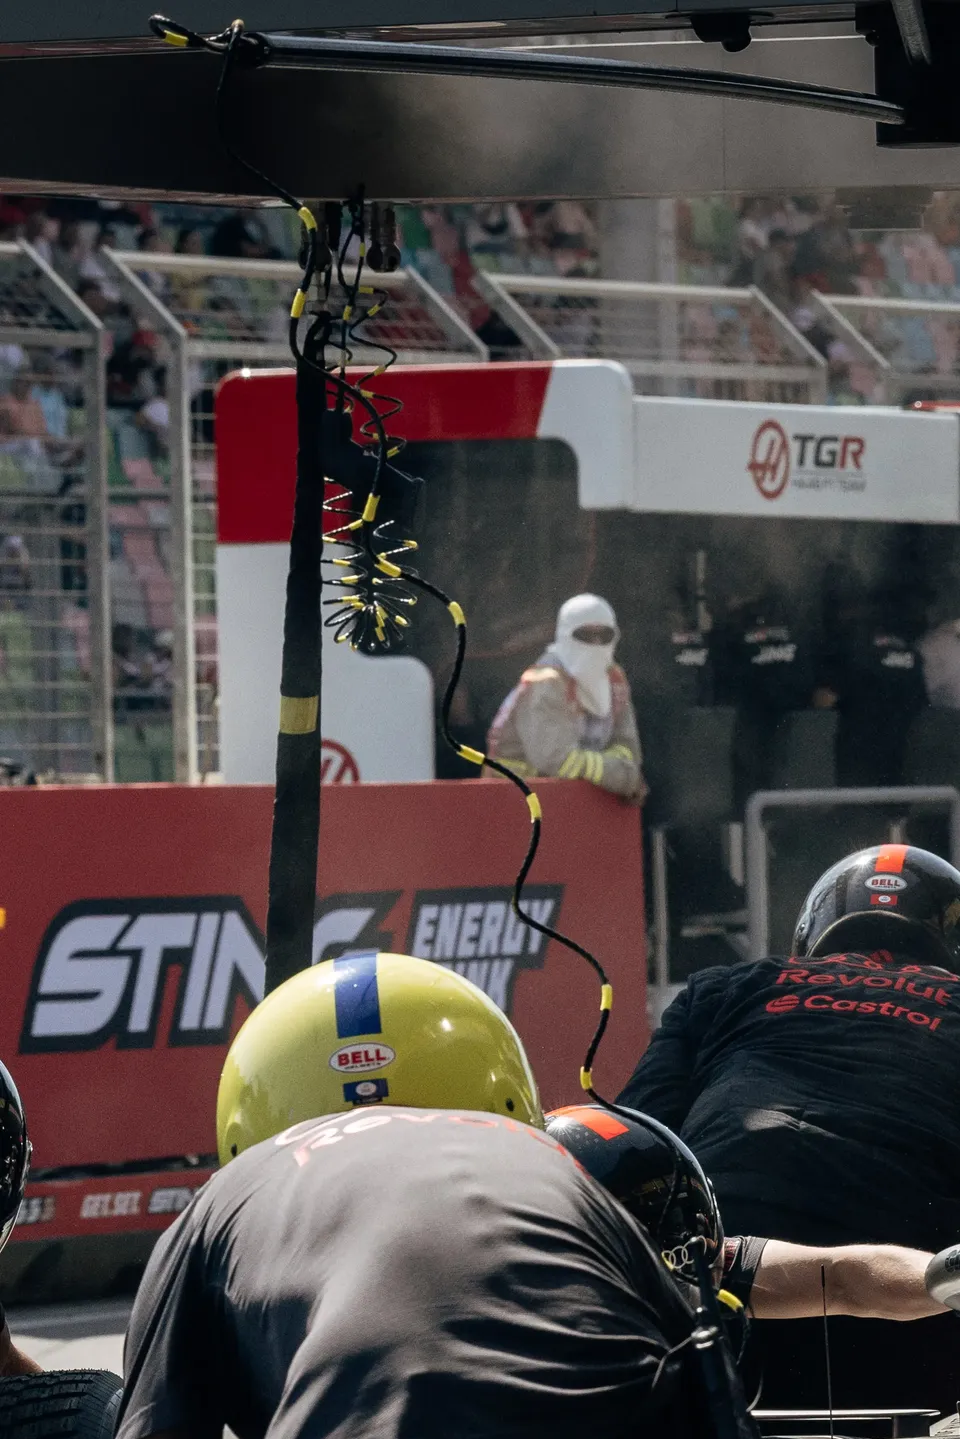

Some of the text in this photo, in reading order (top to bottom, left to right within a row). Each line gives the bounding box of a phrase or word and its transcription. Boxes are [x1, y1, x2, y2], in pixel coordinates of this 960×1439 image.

[793, 434, 865, 470] TGR
[412, 900, 555, 959] ENERGY
[775, 969, 951, 1006] Revolut
[803, 994, 942, 1032] Castrol
[338, 1048, 387, 1067] BELL
